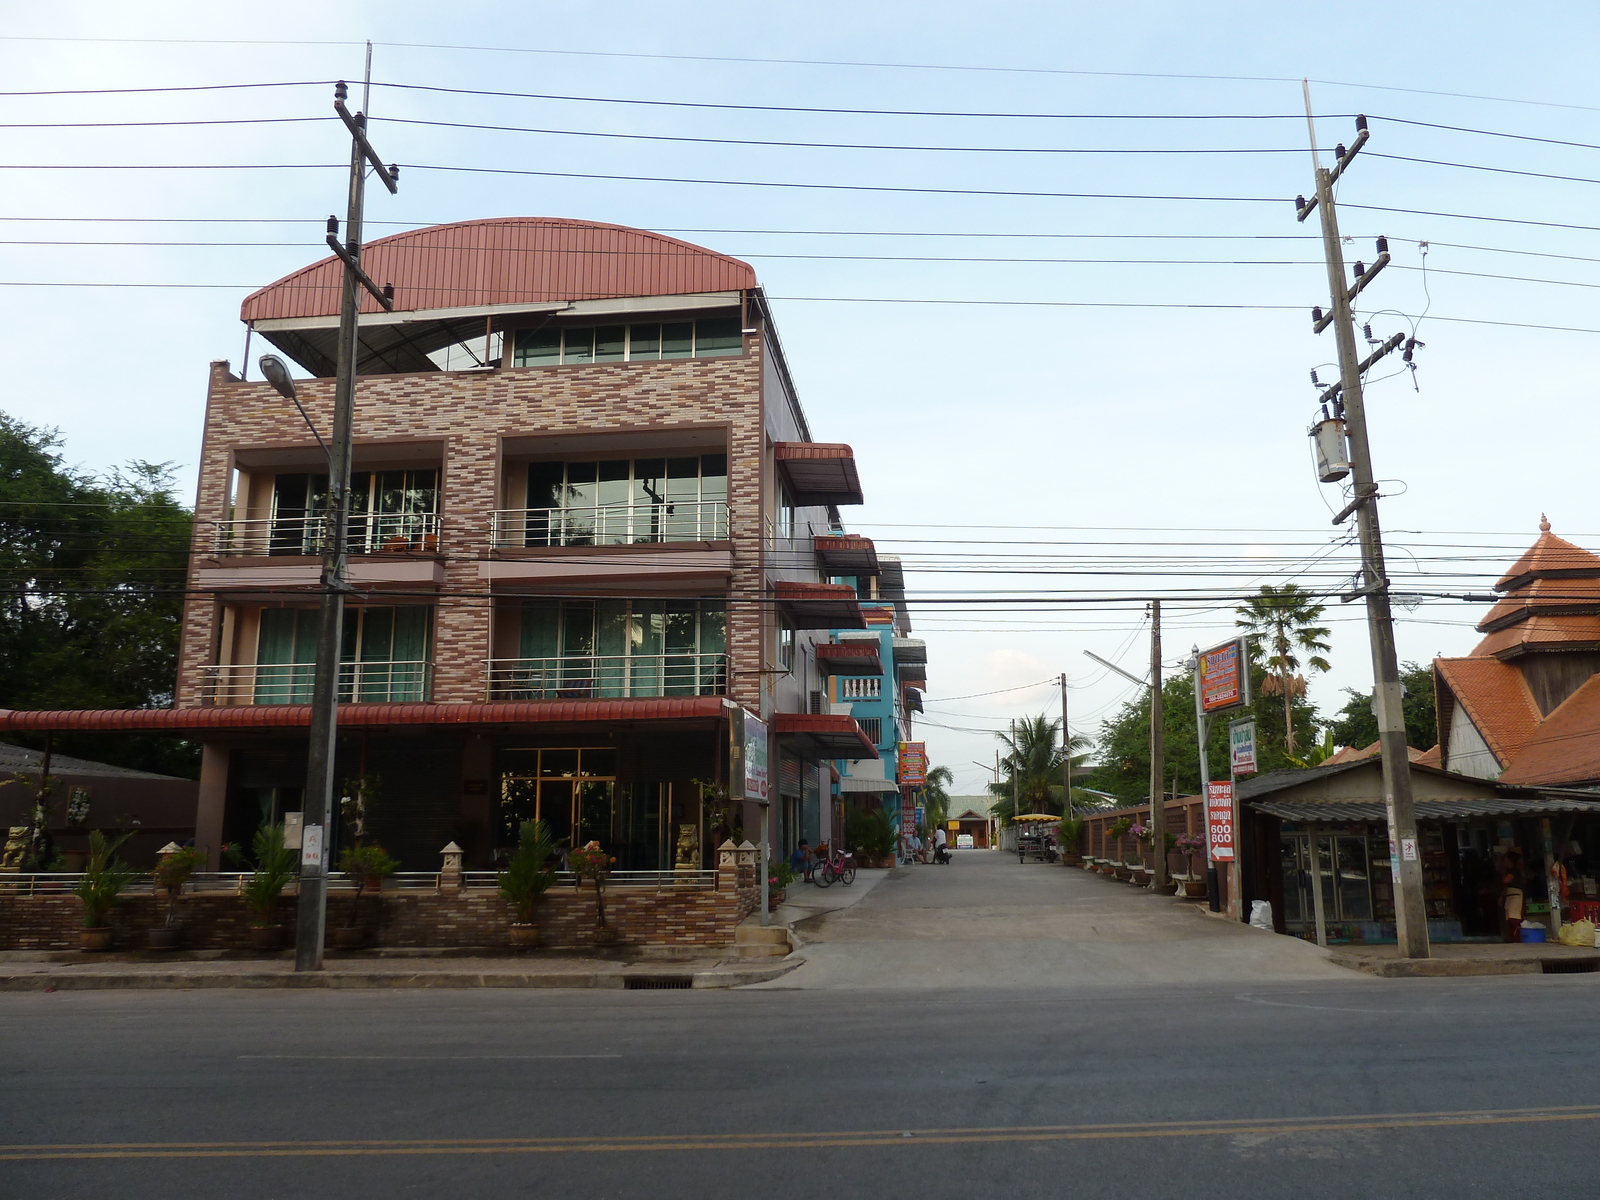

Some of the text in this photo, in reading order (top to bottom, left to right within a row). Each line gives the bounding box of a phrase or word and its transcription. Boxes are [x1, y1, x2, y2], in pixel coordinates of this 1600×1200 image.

[1209, 795, 1231, 807] ห้องพัก
[1211, 825, 1231, 834] 600
[1211, 834, 1231, 843] 800
